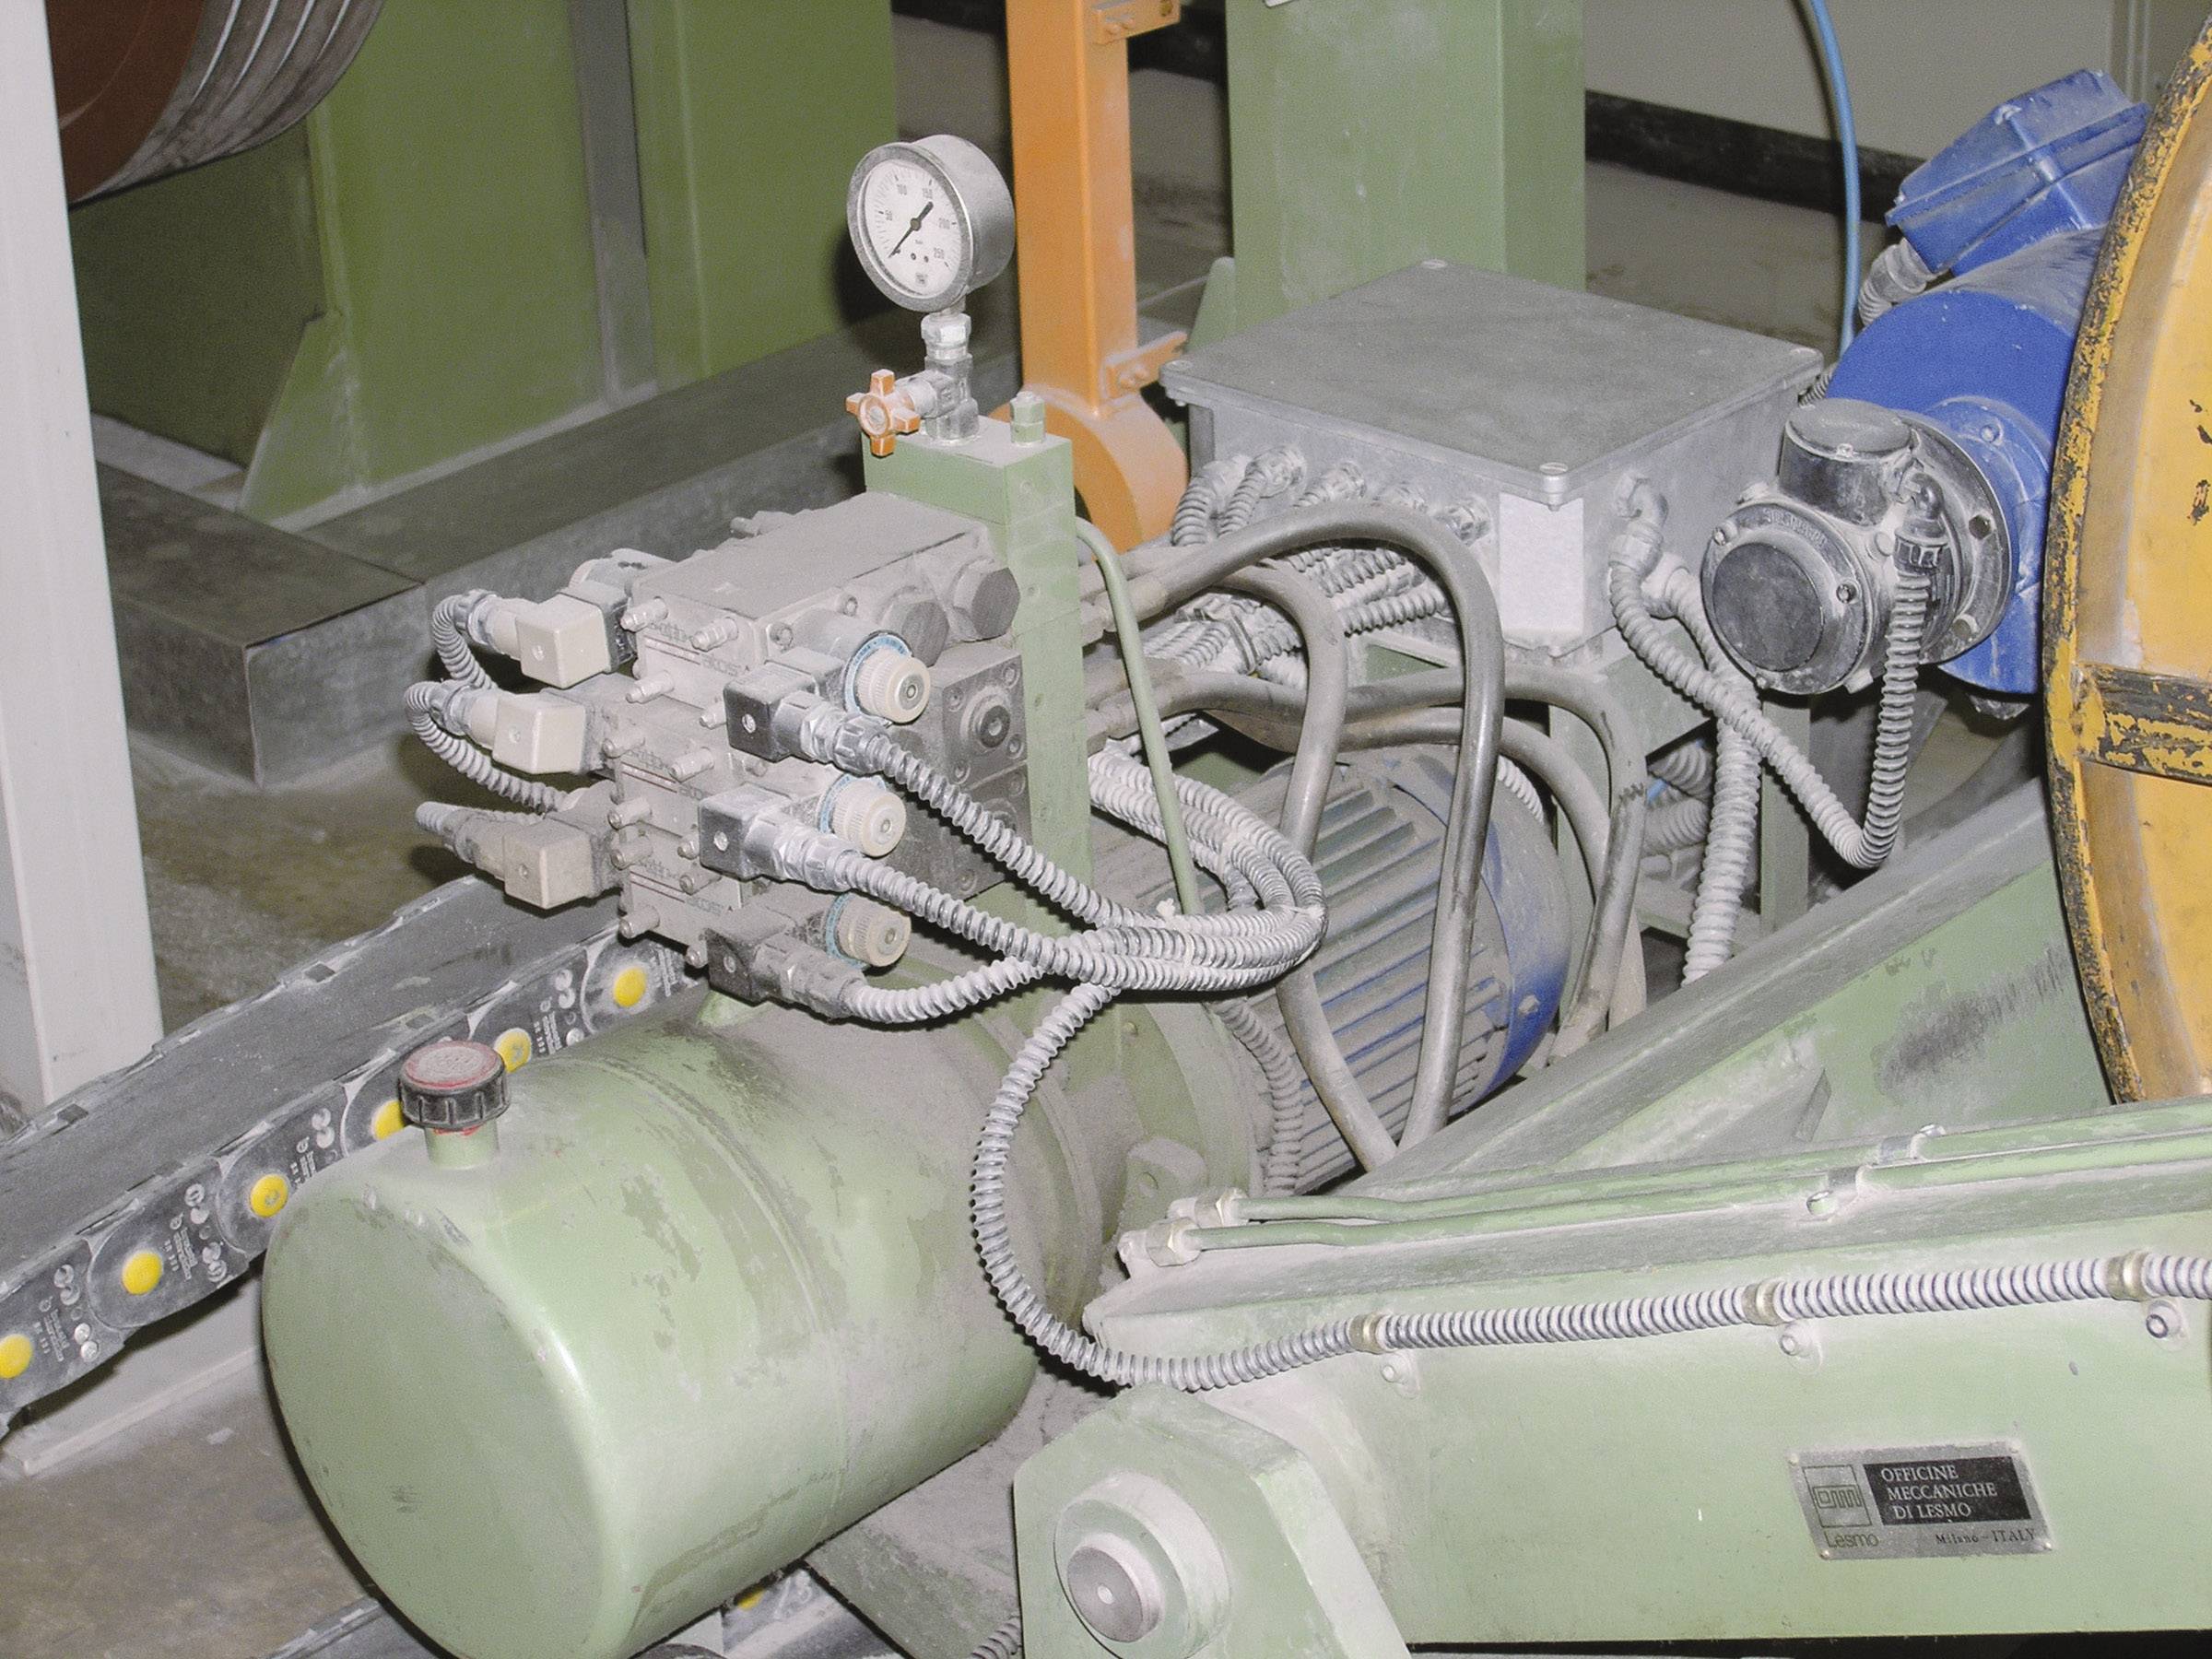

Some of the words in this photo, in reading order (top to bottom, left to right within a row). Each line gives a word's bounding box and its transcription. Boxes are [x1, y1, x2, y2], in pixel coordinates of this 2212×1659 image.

[1880, 1464, 1959, 1483] OFFICINE
[1887, 1482, 1998, 1501] MECCANICHE
[1892, 1505, 1915, 1521] DI
[1918, 1502, 1972, 1519] LESMO
[1824, 1530, 1879, 1549] Lesmo
[1936, 1532, 1979, 1545] Milano
[1992, 1528, 2036, 1543] ITALY
